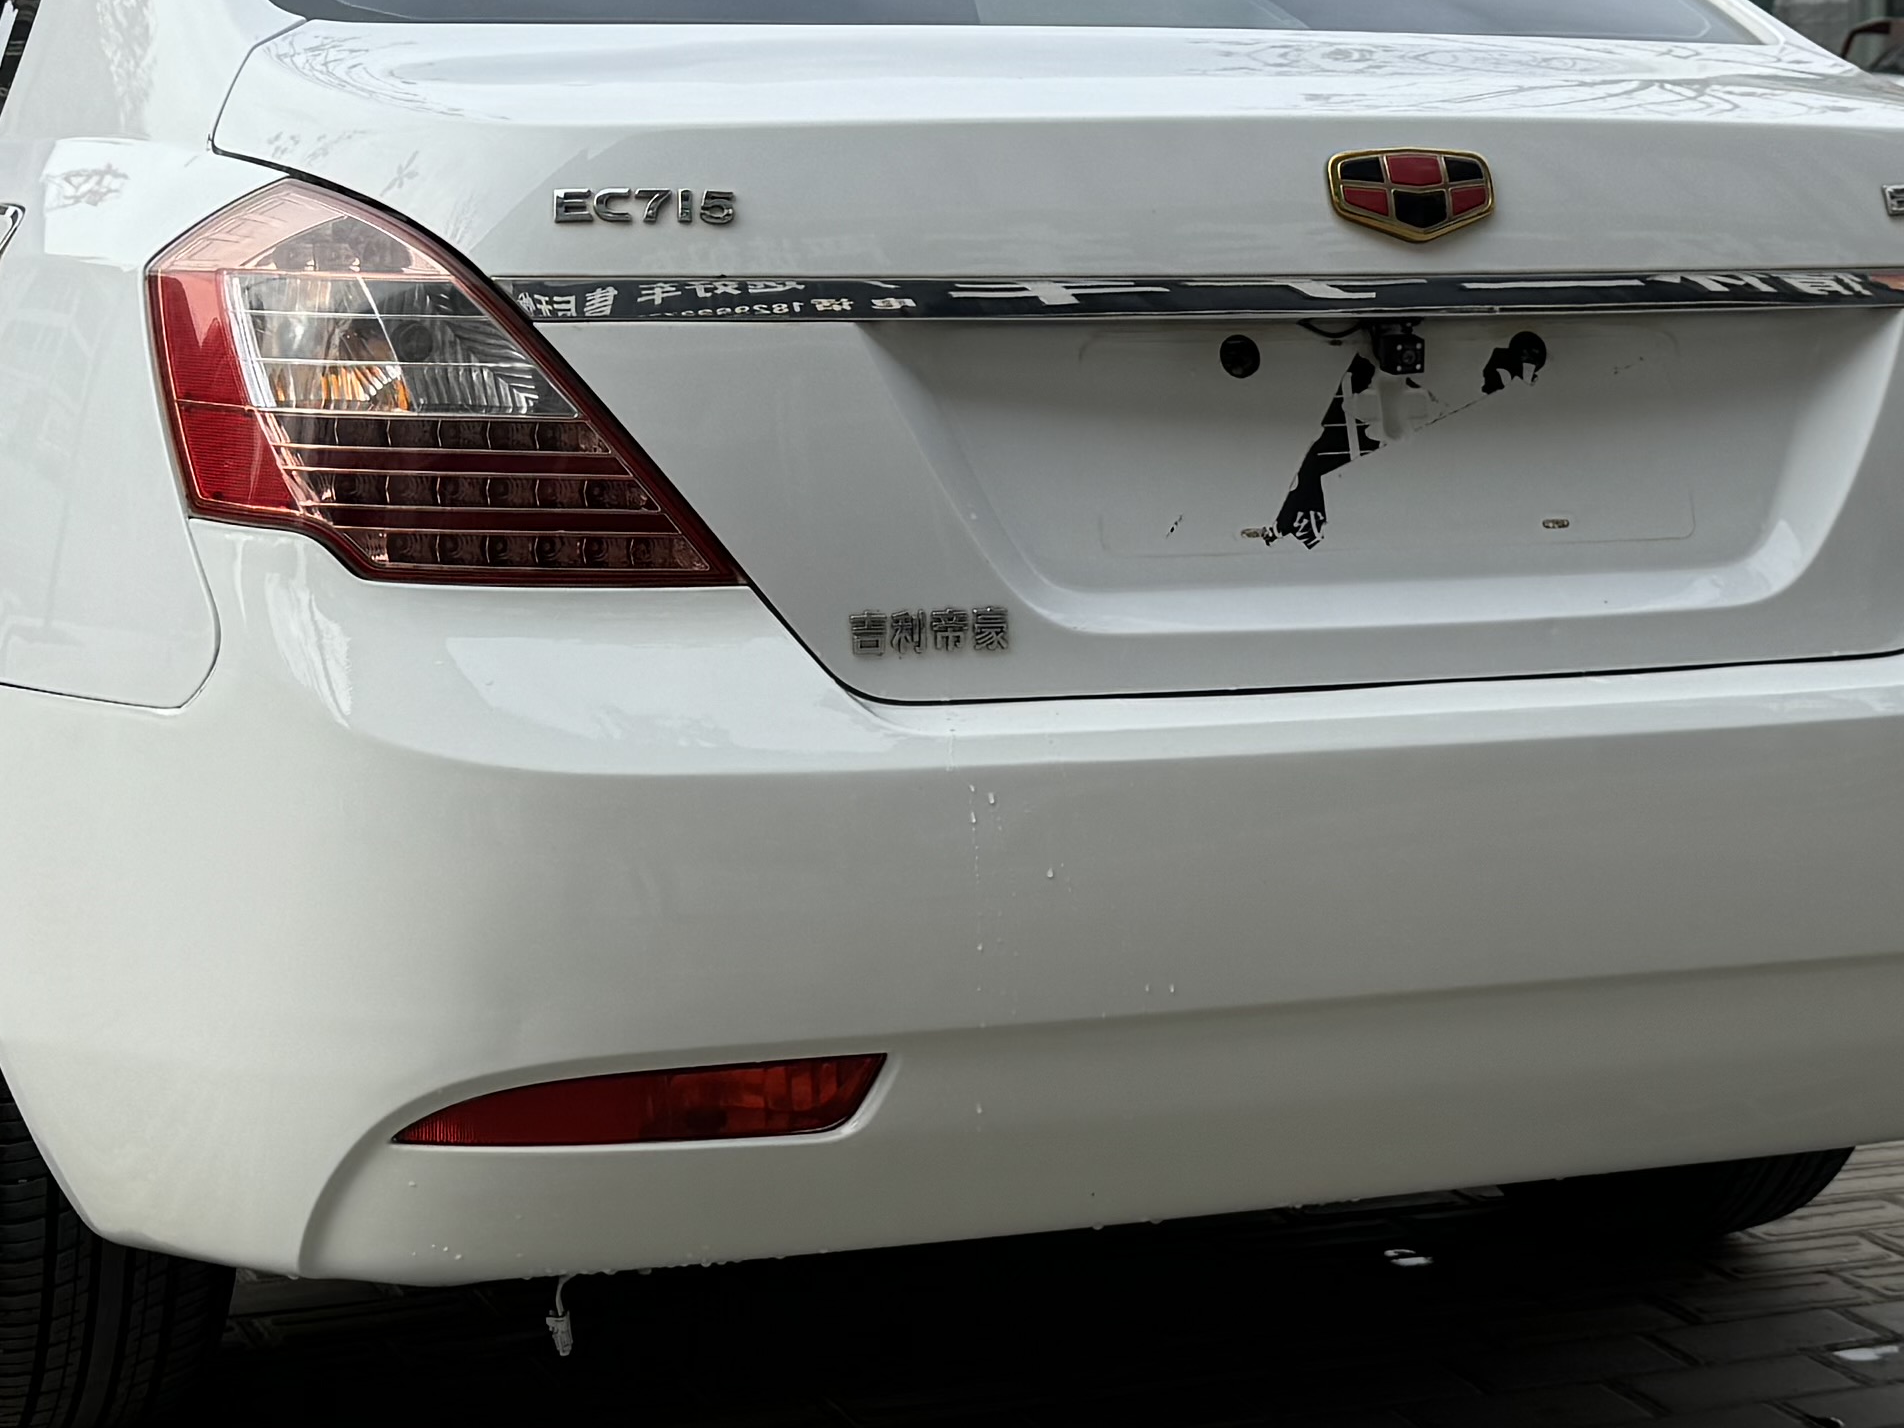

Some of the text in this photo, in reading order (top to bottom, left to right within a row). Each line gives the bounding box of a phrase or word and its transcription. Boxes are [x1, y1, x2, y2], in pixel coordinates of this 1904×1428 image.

[552, 186, 737, 225] EC715
[848, 605, 1010, 656] 吉利帝豪
